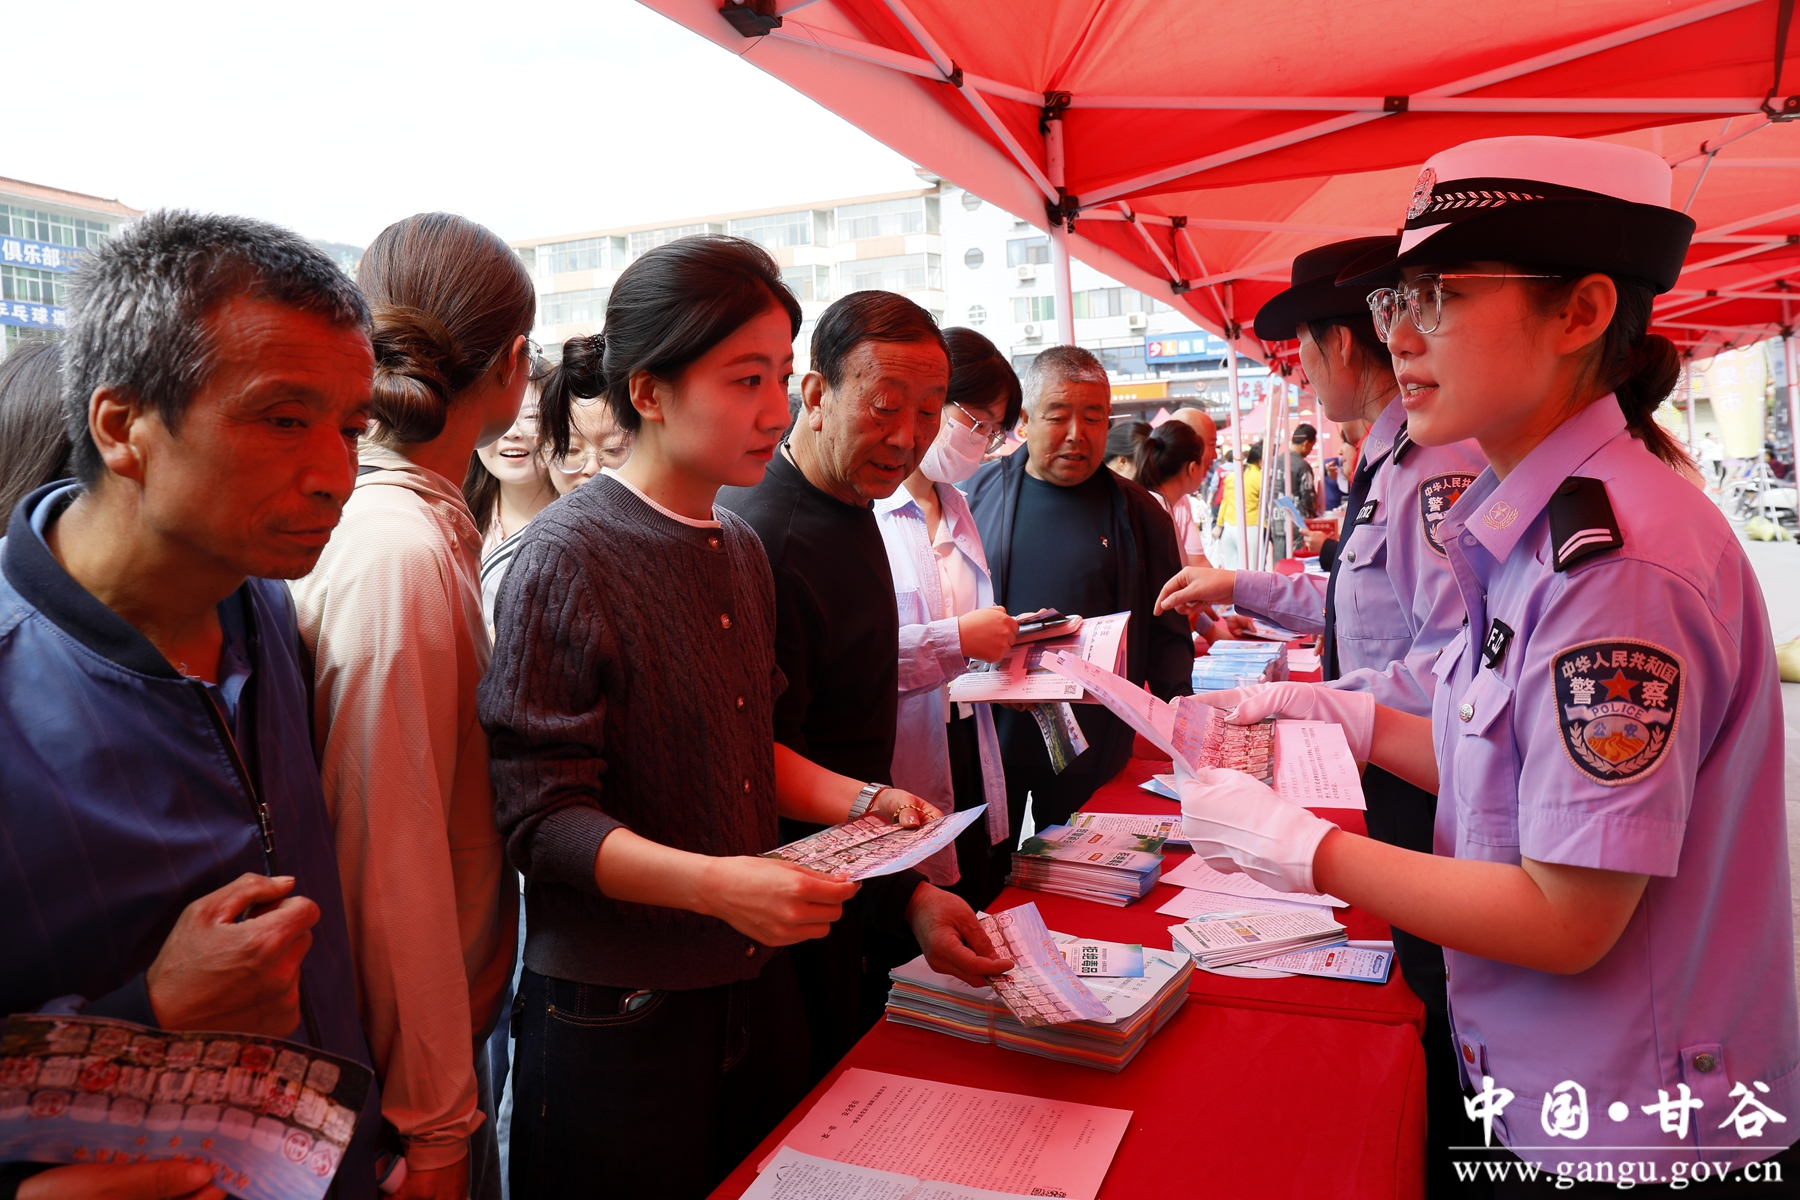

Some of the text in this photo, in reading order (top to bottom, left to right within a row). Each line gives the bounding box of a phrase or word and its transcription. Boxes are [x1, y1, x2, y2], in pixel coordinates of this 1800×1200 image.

[2, 239, 60, 268] 俱乐部
[1428, 497, 1444, 512] 警
[1562, 650, 1679, 684] 中华人民共和国
[1570, 677, 1669, 707] 警 察
[1592, 702, 1644, 719] POLICE
[1593, 722, 1638, 737] 公 安
[1081, 946, 1098, 973] 拒绝毒品
